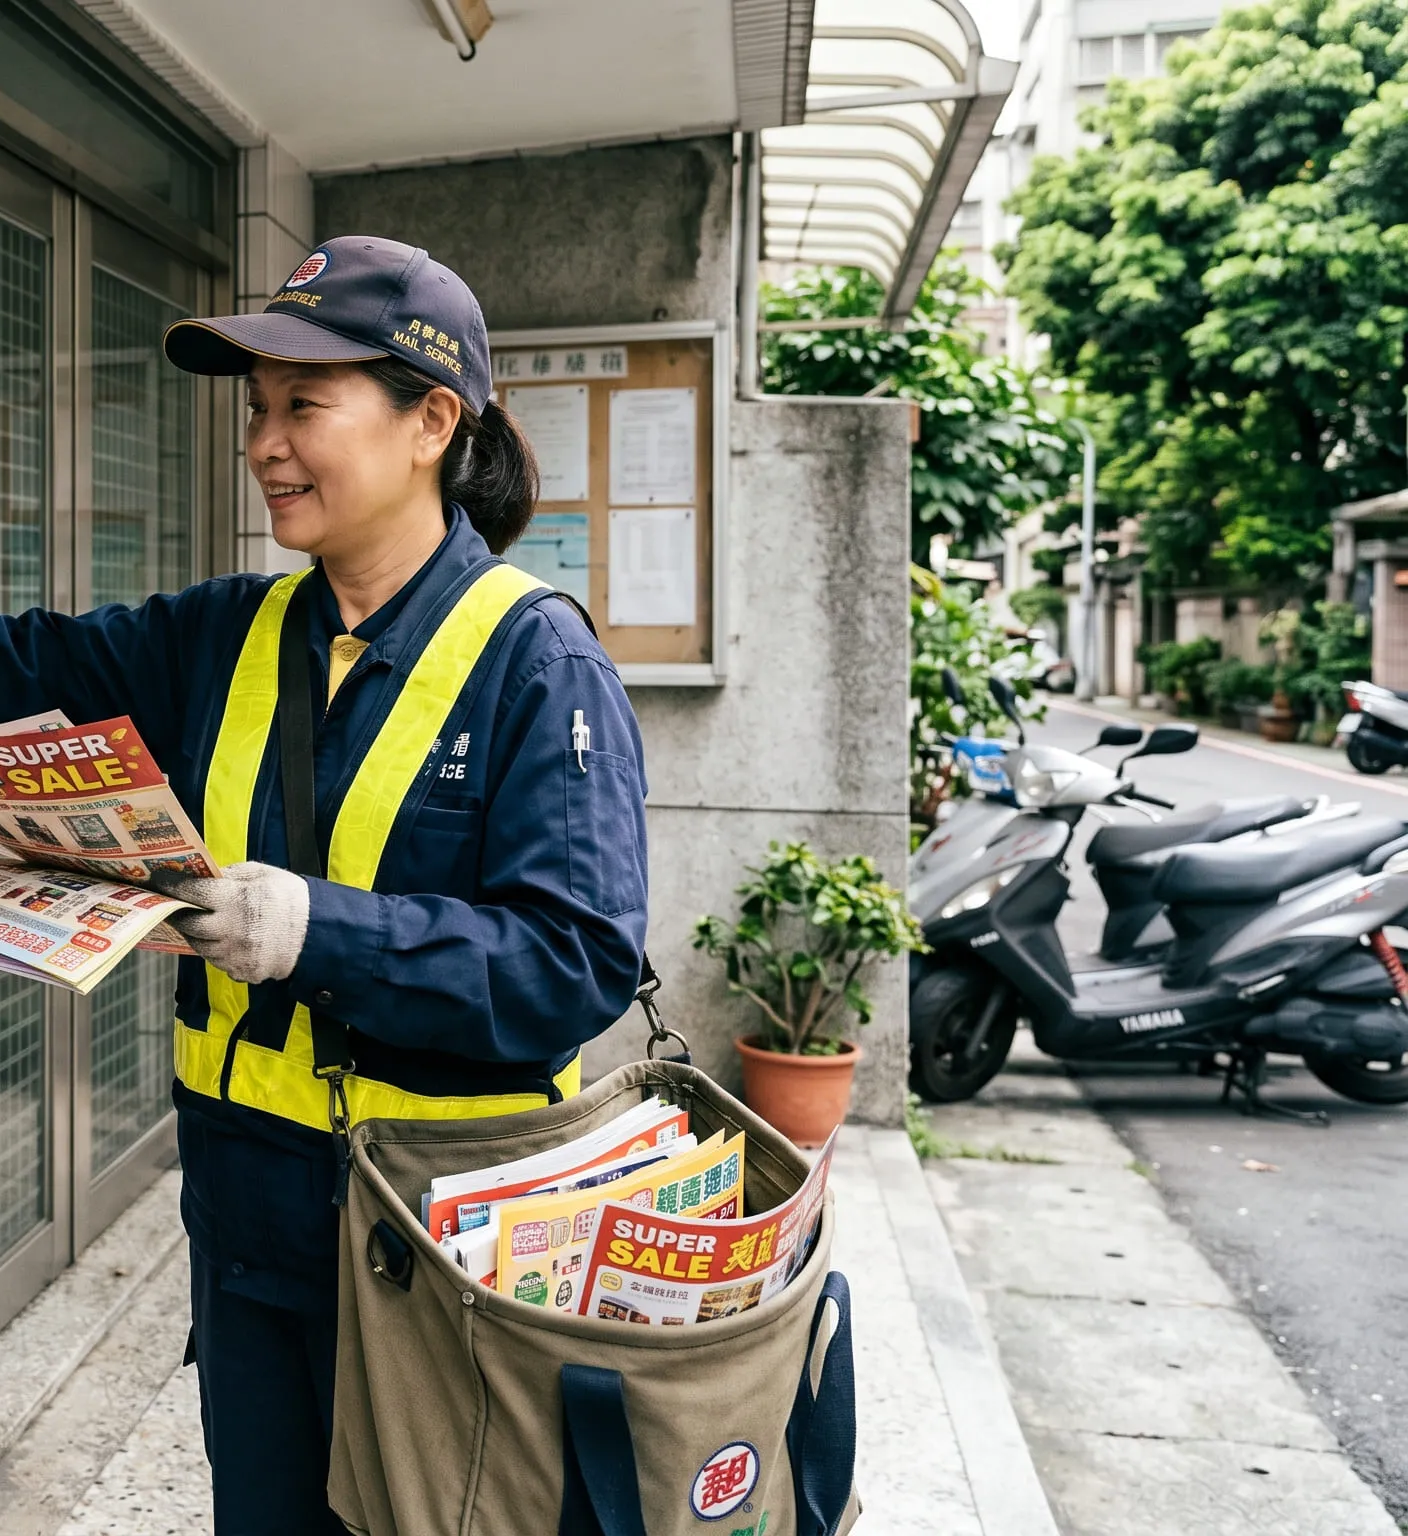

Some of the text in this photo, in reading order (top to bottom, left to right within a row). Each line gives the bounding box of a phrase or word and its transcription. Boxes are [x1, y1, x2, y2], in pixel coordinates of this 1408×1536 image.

[393, 331, 421, 352] MAIL
[6, 758, 132, 795] SALE
[1119, 1008, 1186, 1033] YAMAHA
[612, 1219, 717, 1254] SUPER
[606, 1239, 713, 1280] SALE
